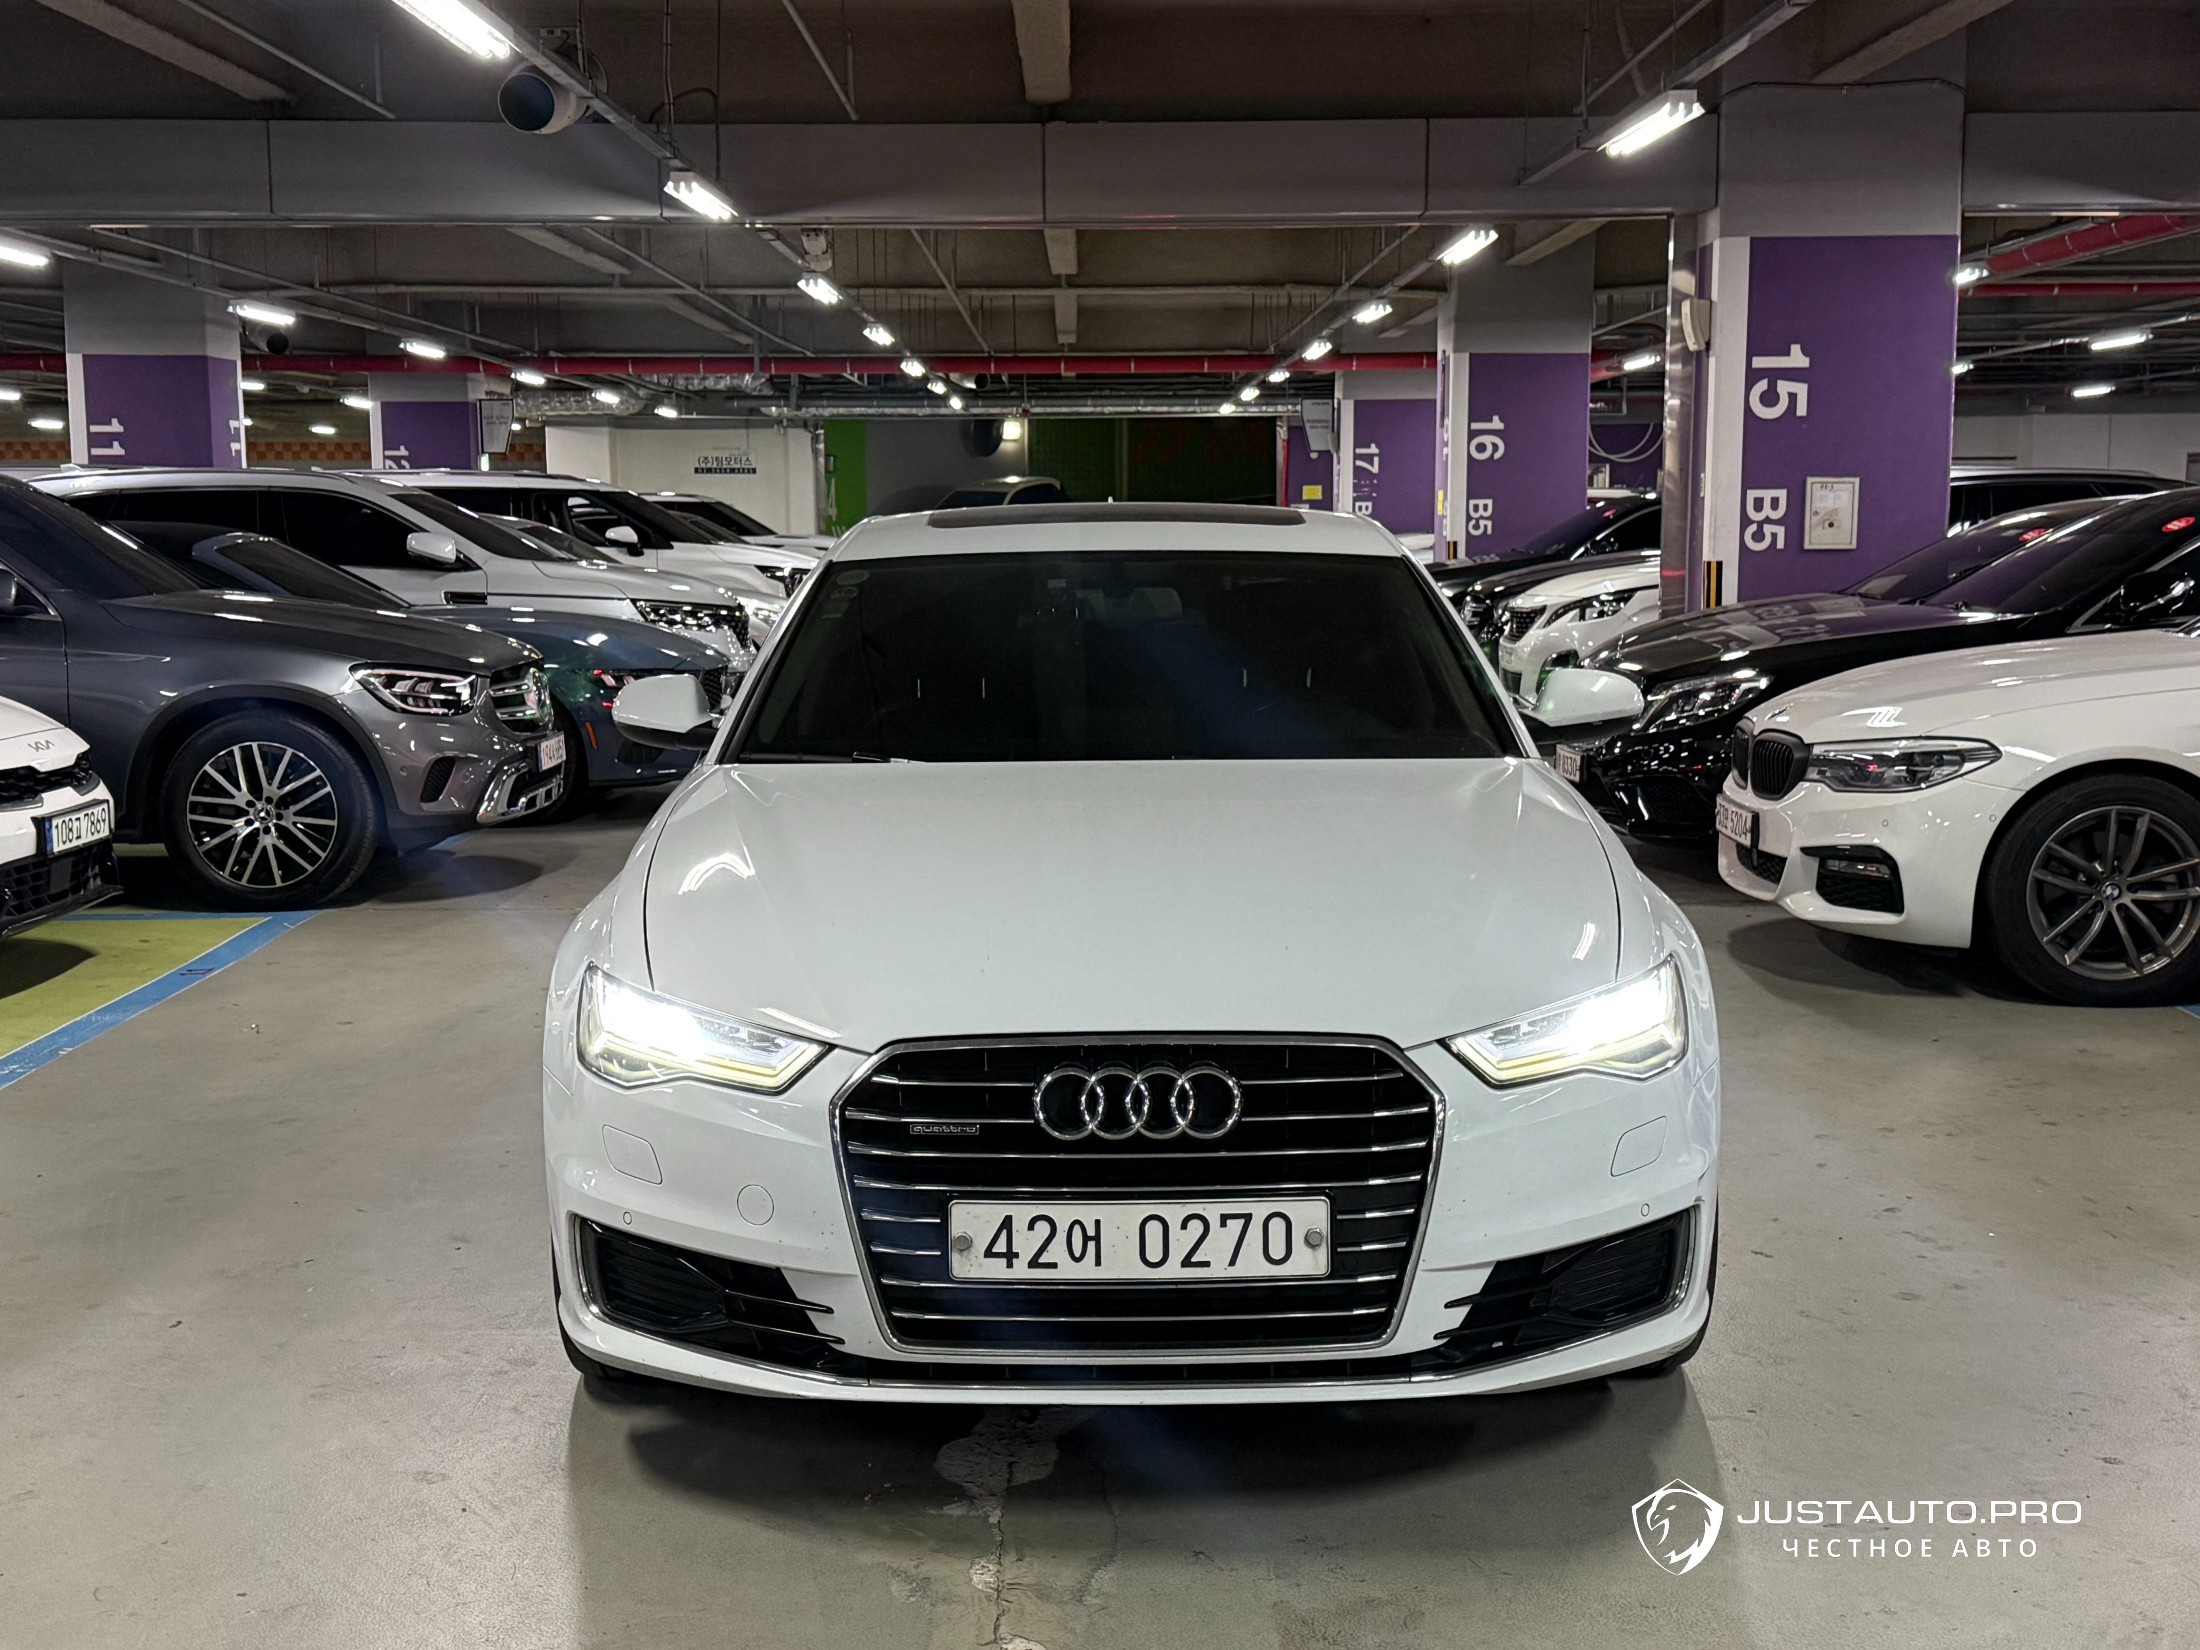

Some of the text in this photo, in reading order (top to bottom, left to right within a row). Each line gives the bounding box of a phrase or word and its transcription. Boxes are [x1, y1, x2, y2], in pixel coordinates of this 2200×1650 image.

[1749, 344, 1810, 419] 15
[89, 418, 125, 455] 11
[1470, 415, 1505, 460] 16
[1355, 443, 1380, 474] 17
[1355, 501, 1373, 516] B
[1468, 499, 1493, 536] B5
[1744, 488, 1788, 551] B5
[54, 807, 107, 848] 108고 7869
[912, 1125, 976, 1135] quattro
[983, 1211, 1293, 1269] 42어 0270
